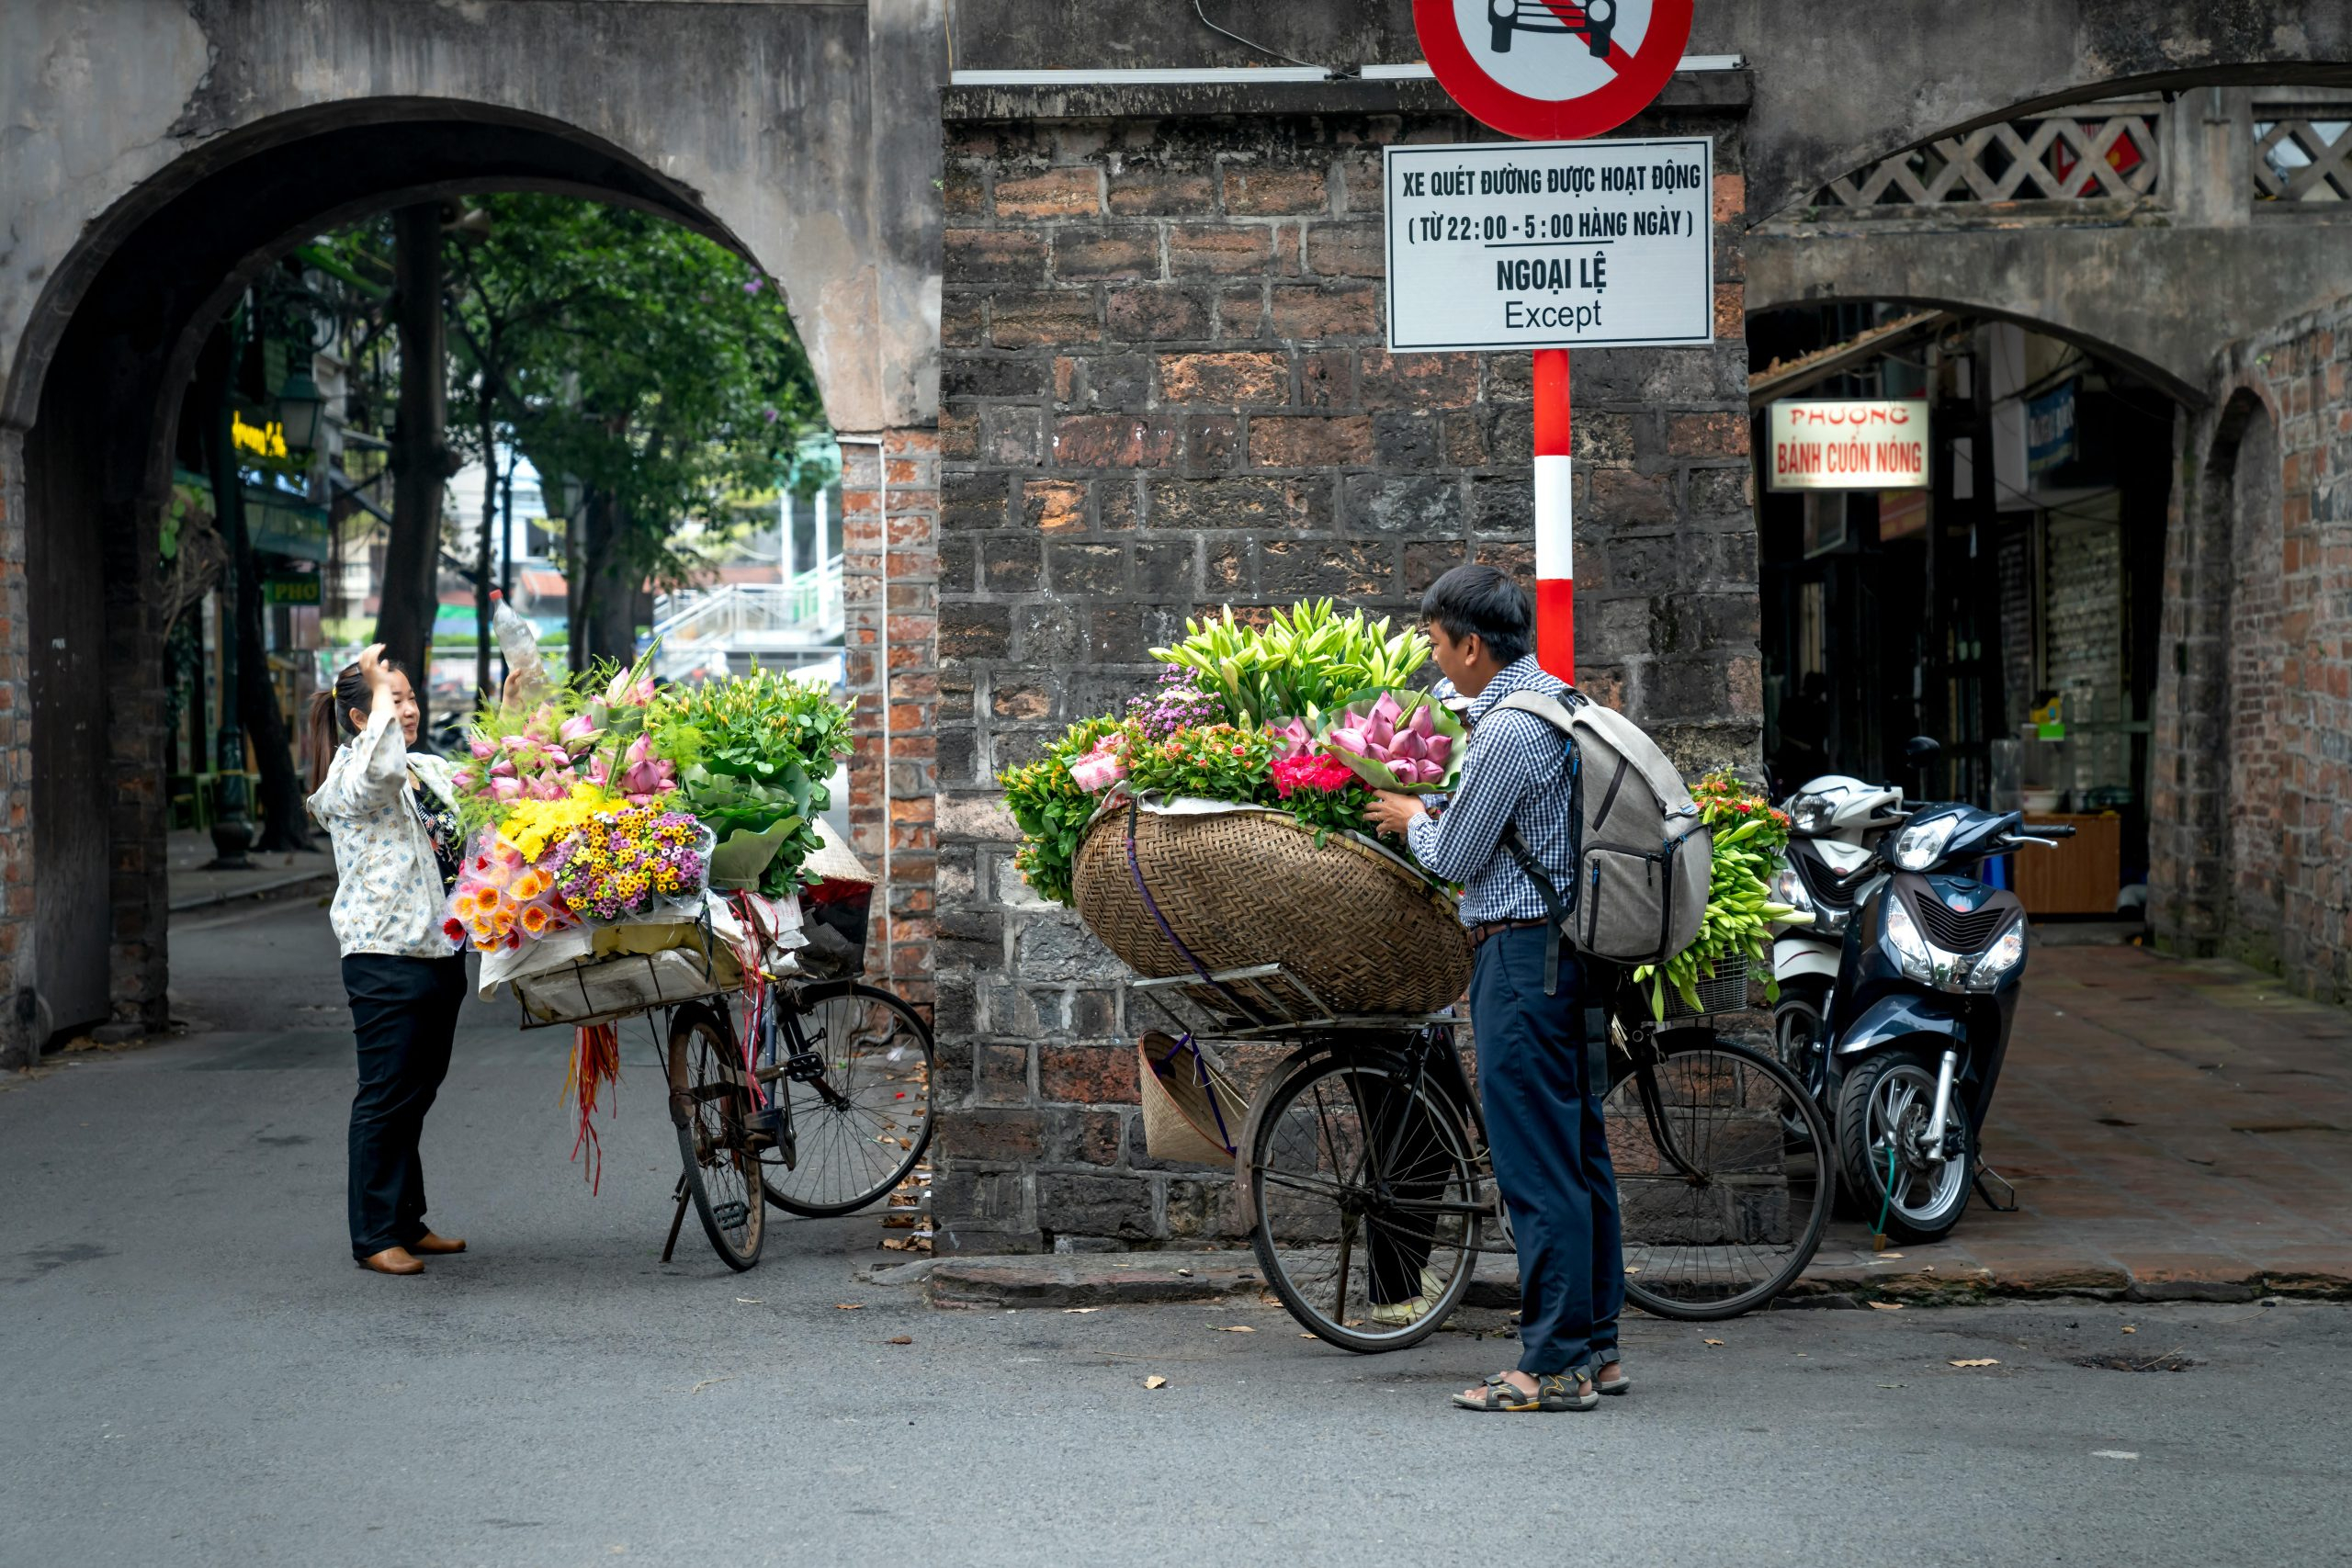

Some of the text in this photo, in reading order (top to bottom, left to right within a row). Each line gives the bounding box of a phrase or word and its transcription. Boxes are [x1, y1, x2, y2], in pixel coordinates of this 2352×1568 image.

[1402, 159, 1701, 197] XE QUÉT ĐƯỜNG ĐƯỢC HOẠT ĐỘNG
[1447, 215, 1507, 241] 22:00
[1578, 207, 1628, 238] HÀNG
[1497, 251, 1607, 295] NGOẠI LỆ
[1505, 299, 1602, 333] Except
[1778, 434, 1922, 473] BÁNH CUỐN NÓNG
